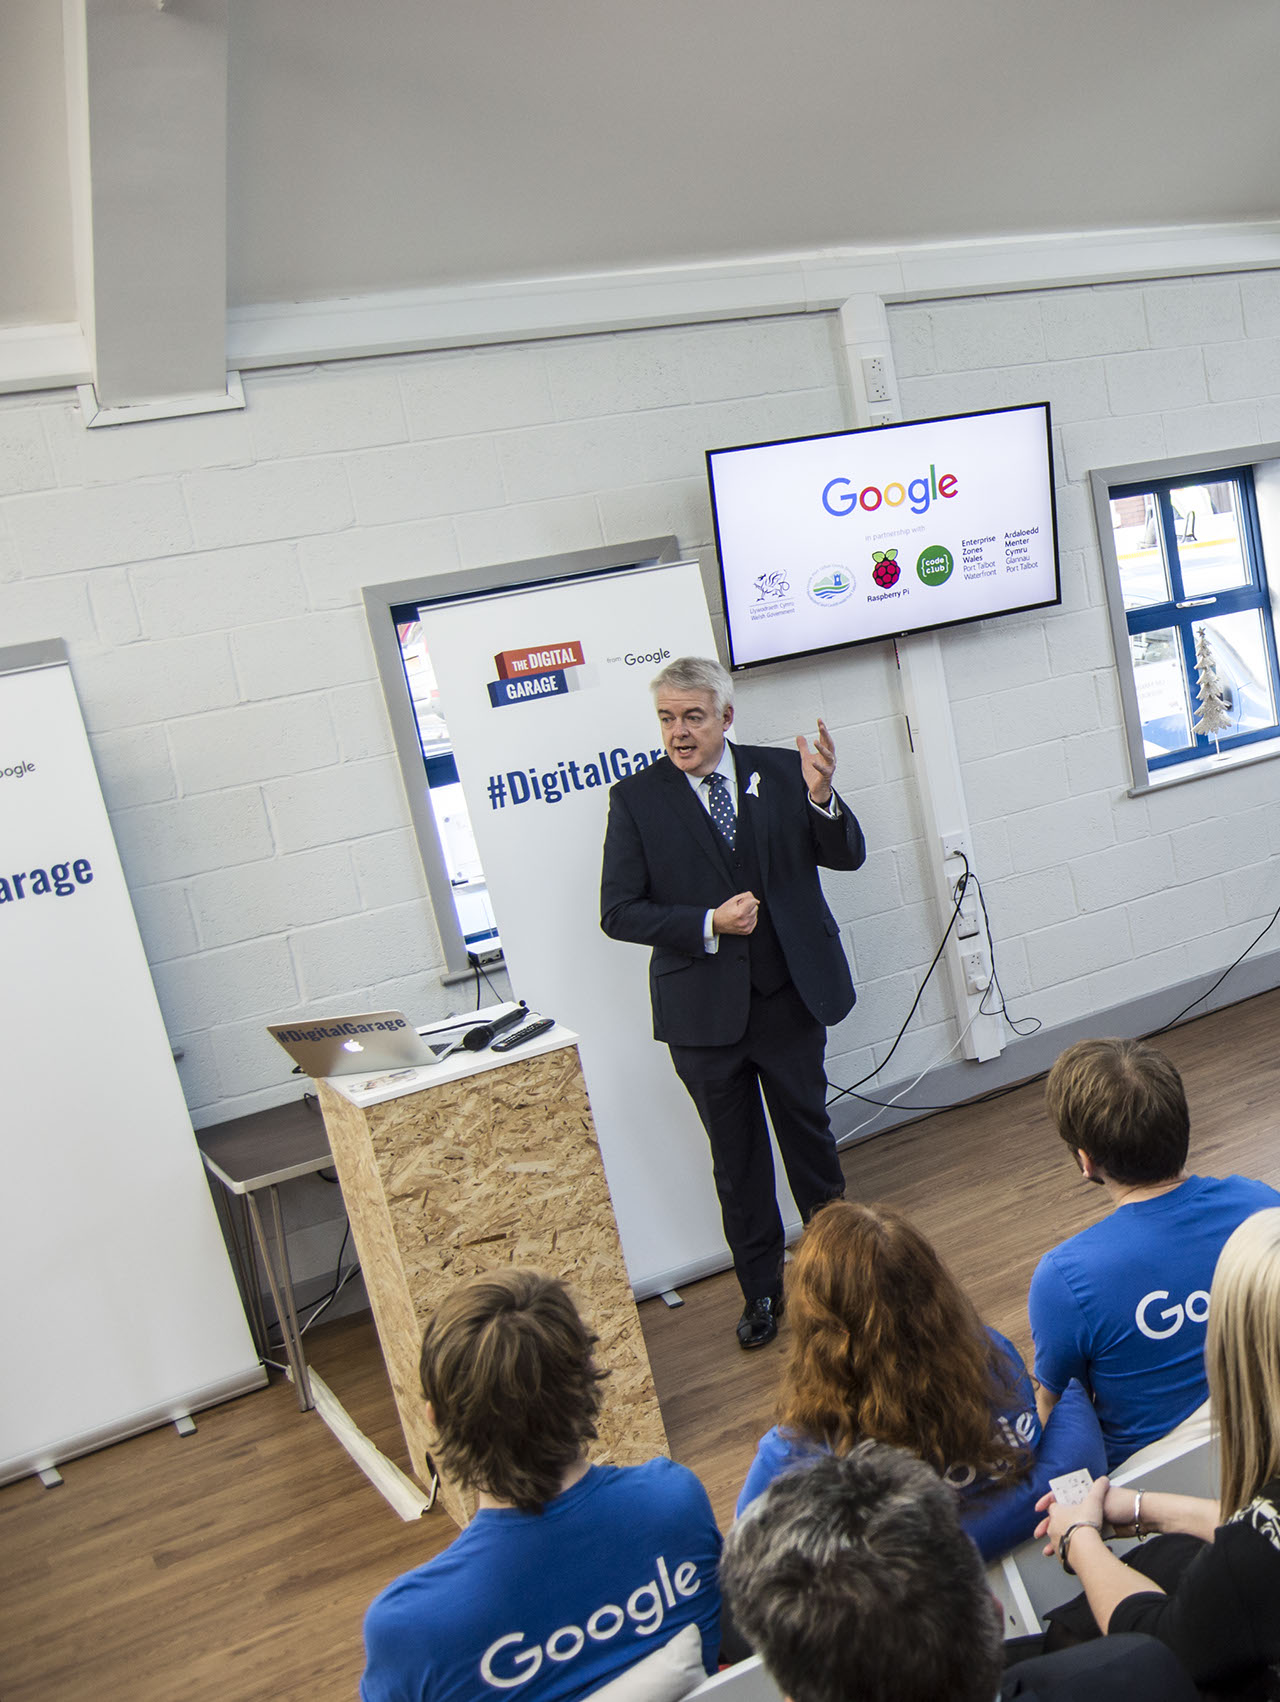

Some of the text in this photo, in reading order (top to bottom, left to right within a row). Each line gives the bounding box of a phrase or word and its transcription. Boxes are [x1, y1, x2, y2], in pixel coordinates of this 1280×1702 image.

[822, 464, 959, 517] Google
[873, 528, 911, 541] partnership
[1004, 526, 1039, 539] Ardaloedd
[961, 535, 997, 547] Enterprise
[1004, 538, 1030, 548] Menter
[962, 546, 983, 556] Zones
[1005, 547, 1028, 557] Cymru
[925, 557, 945, 566] code
[962, 554, 983, 564] Wales
[925, 565, 945, 574] club
[963, 560, 996, 573] Port Talbot
[1006, 561, 1039, 573] Port Talbot
[963, 569, 997, 581] Waterfront
[867, 588, 910, 602] Raspberry Pi
[511, 647, 577, 672] THE DIGITAL
[606, 648, 671, 666] from Google
[505, 675, 559, 700] GARAGE
[487, 747, 668, 810] #DigitalGar
[276, 1018, 407, 1043] #DigitalGarage
[480, 1555, 701, 1688] Google
